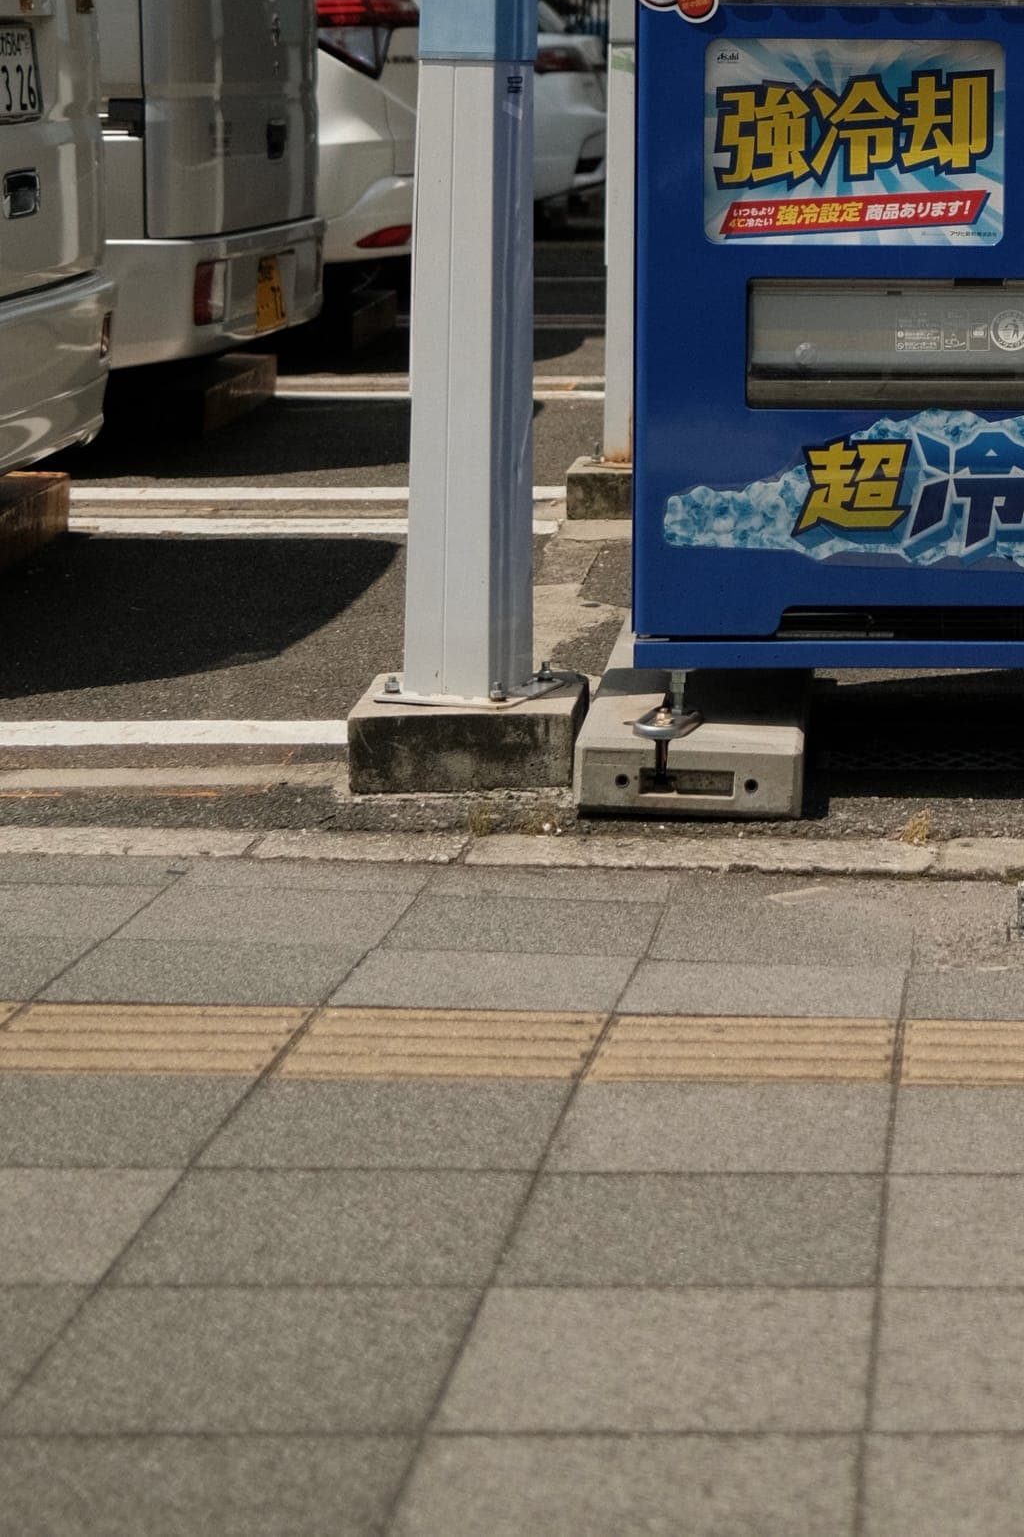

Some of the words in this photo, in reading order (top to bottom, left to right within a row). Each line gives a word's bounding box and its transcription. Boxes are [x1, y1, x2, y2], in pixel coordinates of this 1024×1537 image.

[716, 52, 740, 62] Asahi
[716, 71, 992, 188] 強冷却
[729, 216, 773, 228] 4℃冷たい
[732, 206, 775, 217] いつもより
[775, 201, 863, 226] 強冷設定
[864, 199, 971, 221] 商品あります!
